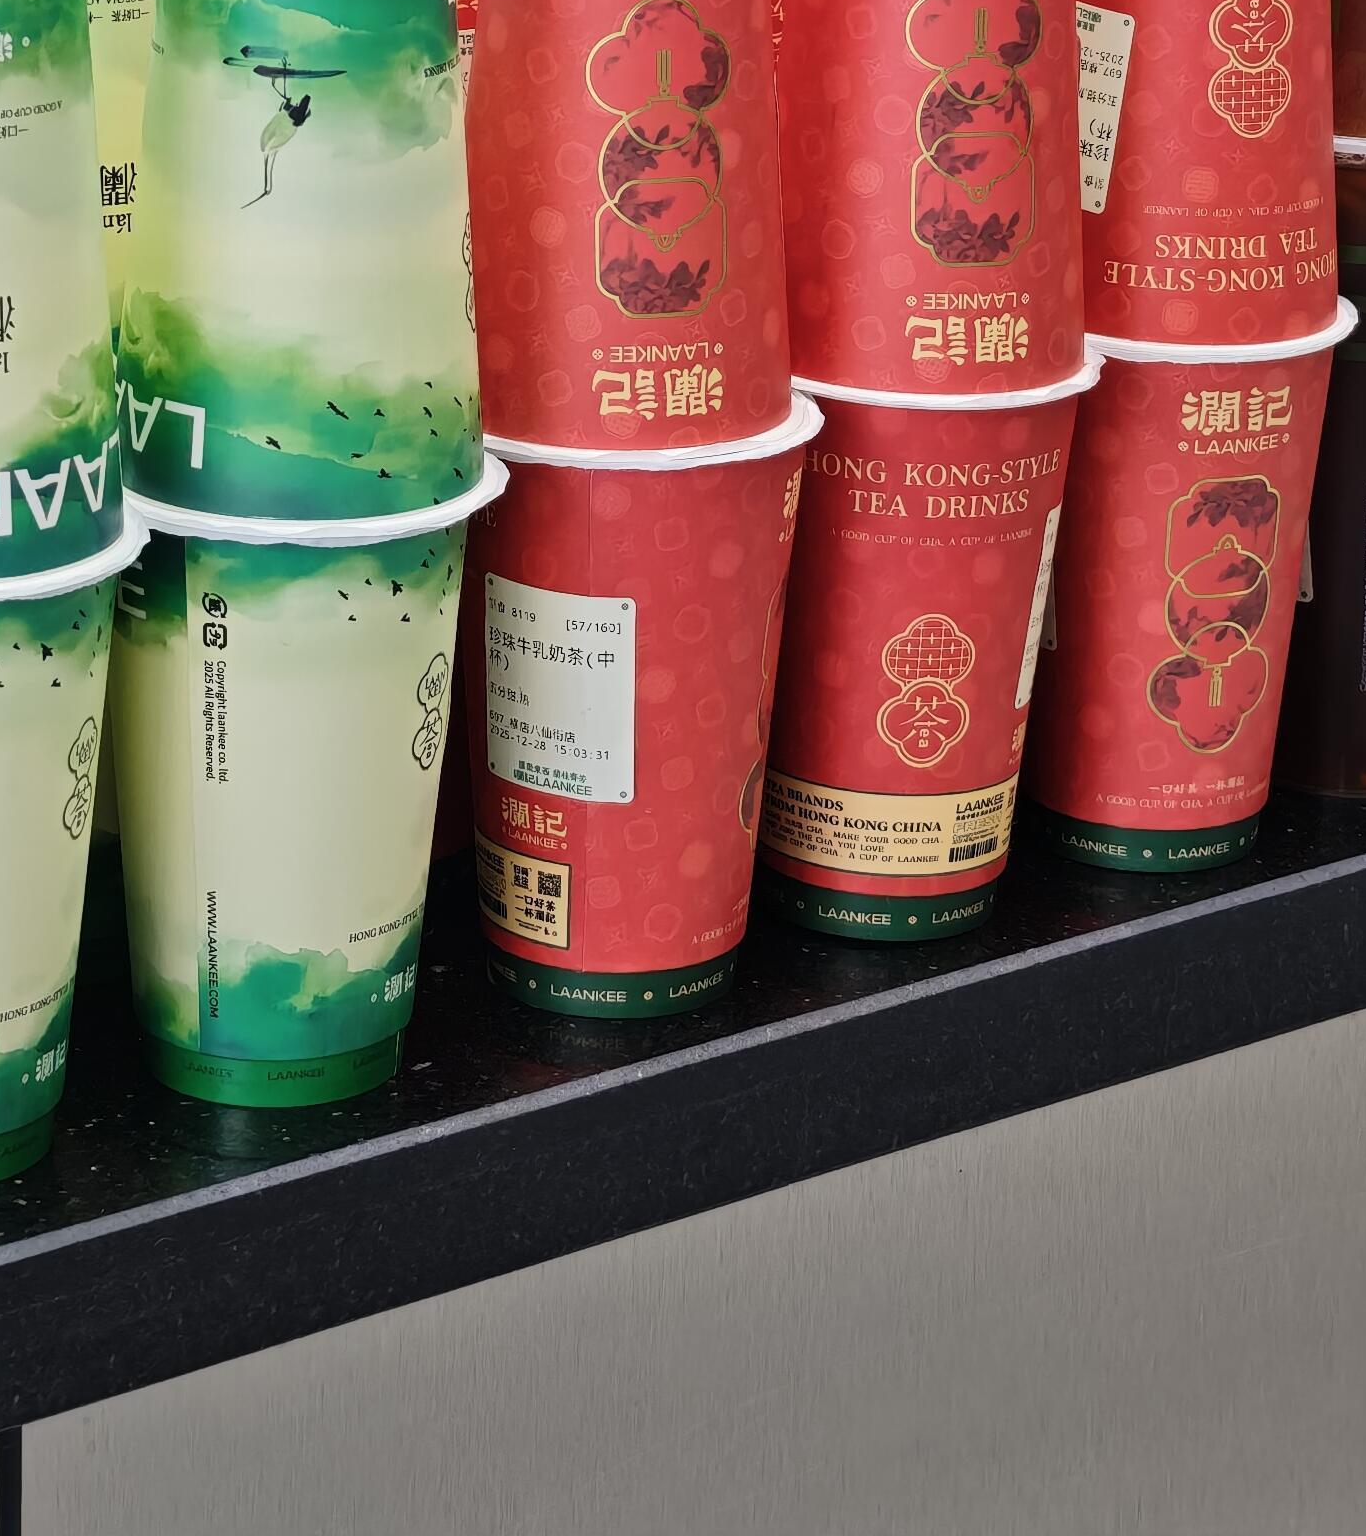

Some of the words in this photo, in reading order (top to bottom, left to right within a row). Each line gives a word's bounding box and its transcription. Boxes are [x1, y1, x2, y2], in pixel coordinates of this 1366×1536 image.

[1155, 235, 1267, 259] DRINKS
[1279, 234, 1318, 254] TEA
[1104, 260, 1287, 292] KONG-STYLE
[923, 293, 1017, 310] LAANKEE
[609, 342, 709, 361] LAANKEE
[1181, 386, 1293, 435] 瀾記
[1193, 434, 1279, 455] LAANKEE
[805, 450, 887, 484] HONG
[903, 448, 1060, 486] KONG-STYLE
[847, 489, 907, 515] TEA
[926, 489, 1030, 519] DRINKS
[489, 625, 615, 670] 珍珠牛乳奶茶(中
[204, 660, 213, 683] 2025
[205, 686, 214, 698] All
[215, 661, 228, 709] Copyright
[217, 712, 227, 749] laankee
[205, 734, 215, 781] Reserved.
[788, 789, 844, 811] BRANDS
[956, 791, 1004, 814] LAANKEE
[798, 808, 839, 826] HONG
[844, 817, 887, 832] KONG
[892, 821, 942, 832] CHINA
[508, 830, 558, 850] LAANKEE
[1061, 832, 1128, 857] LAANKEE
[1168, 840, 1230, 859] LAANKEE
[817, 903, 892, 926] LAANKEE
[932, 900, 984, 924] LAANKEE
[207, 891, 219, 1018] WWW.LAANKEE.COM
[550, 984, 627, 1003] LAANKEE
[668, 970, 724, 998] LAANKEE
